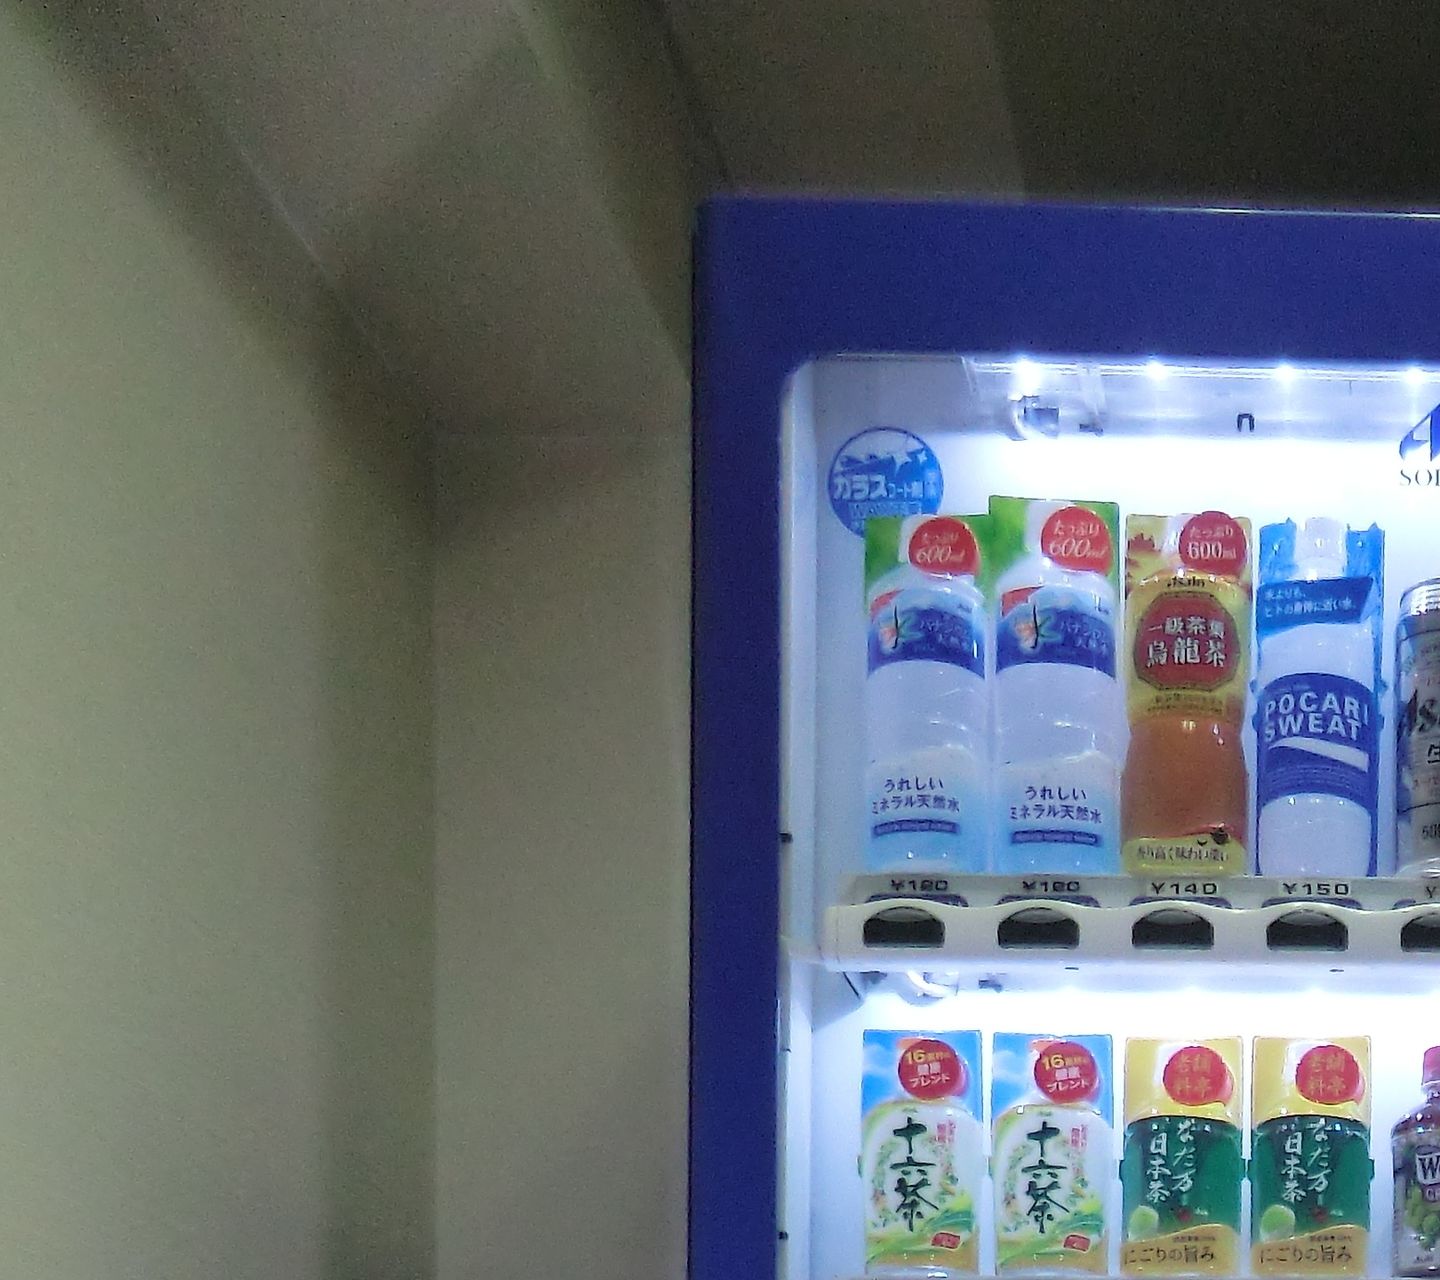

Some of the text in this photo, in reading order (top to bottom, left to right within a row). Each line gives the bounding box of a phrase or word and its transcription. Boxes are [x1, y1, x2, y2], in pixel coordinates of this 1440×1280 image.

[1186, 541, 1238, 561] 600ml
[1146, 636, 1226, 669] 烏龍茶
[1264, 690, 1369, 724] POCARI
[1263, 711, 1362, 746] SWEAT
[884, 777, 945, 794] うれしい
[1024, 785, 1088, 802] うれしい
[890, 1117, 941, 1232] 十六茶
[1020, 1121, 1070, 1234] 十六茶
[1145, 1133, 1172, 1203] 日本茶
[1281, 1132, 1308, 1203] 日本茶
[1123, 1243, 1216, 1266] にごりの旨み
[1258, 1243, 1353, 1265] にごりの旨み
